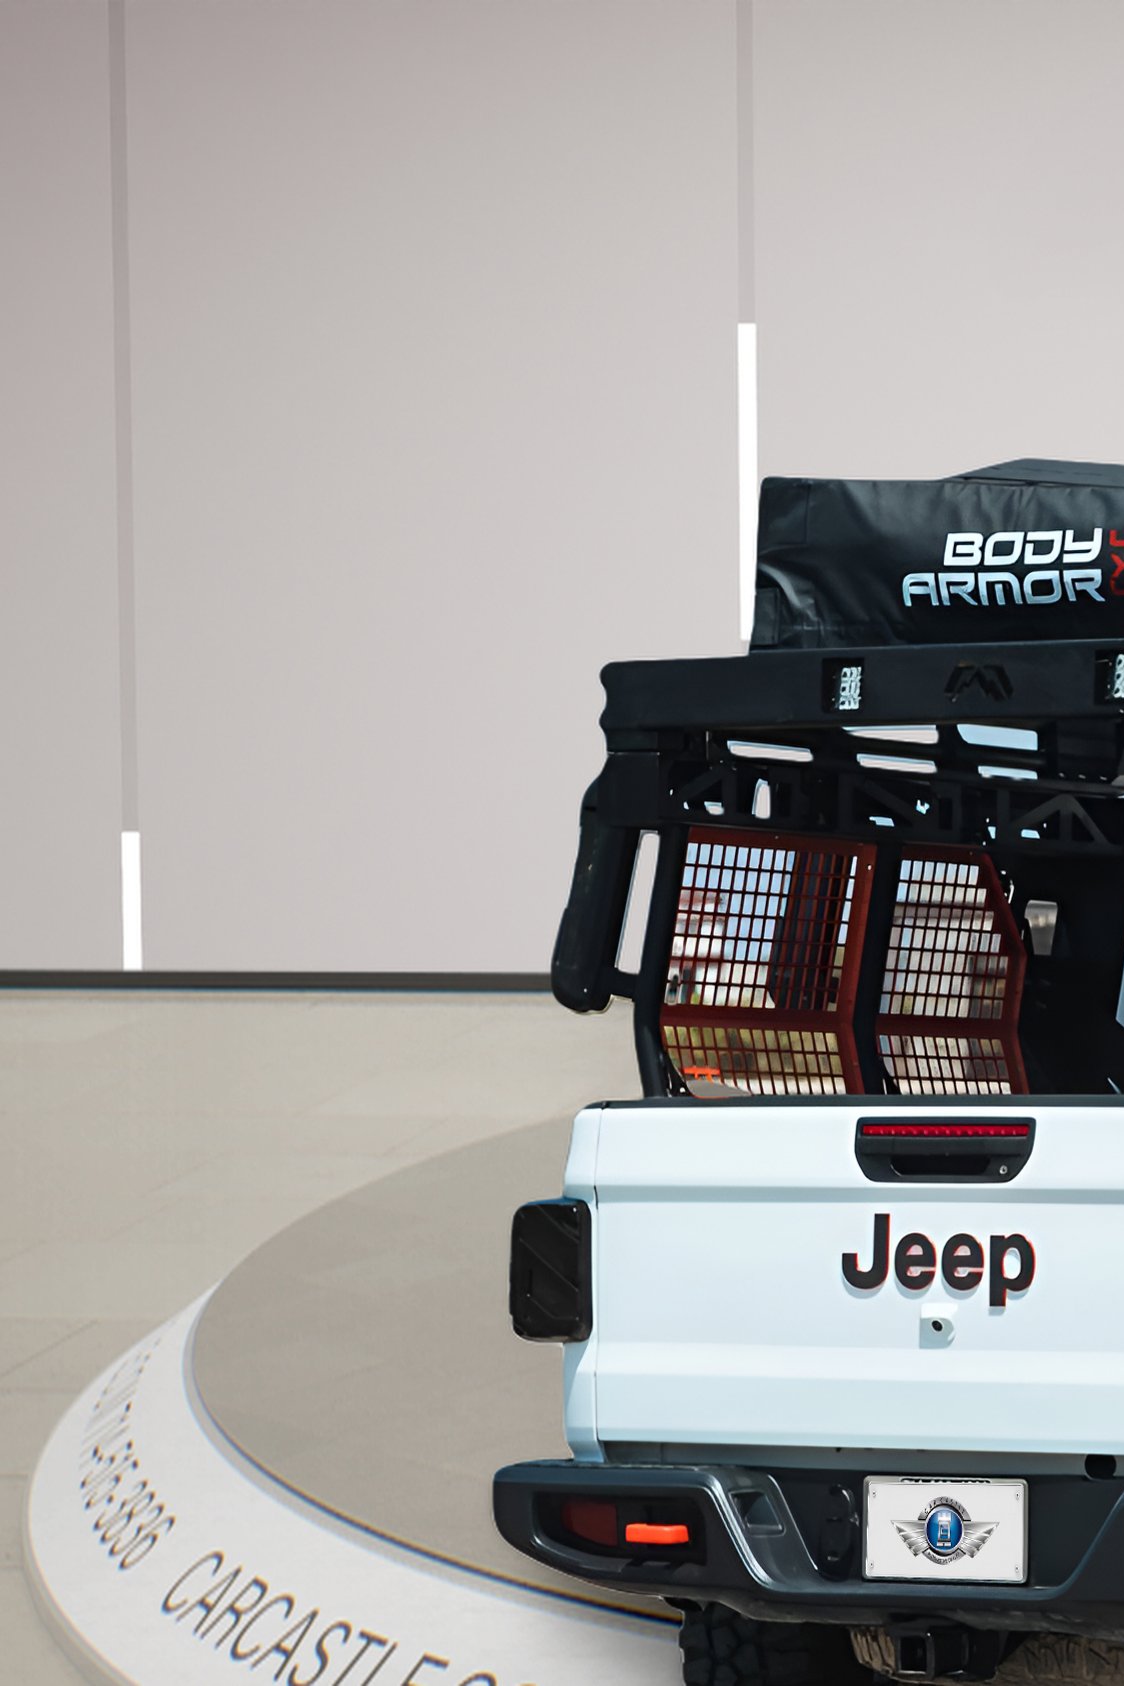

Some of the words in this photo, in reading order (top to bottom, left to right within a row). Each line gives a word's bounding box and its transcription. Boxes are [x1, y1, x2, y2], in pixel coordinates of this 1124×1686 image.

[943, 527, 1103, 567] BODY
[902, 568, 1106, 607] ARMOR
[842, 1212, 1036, 1307] Jeep
